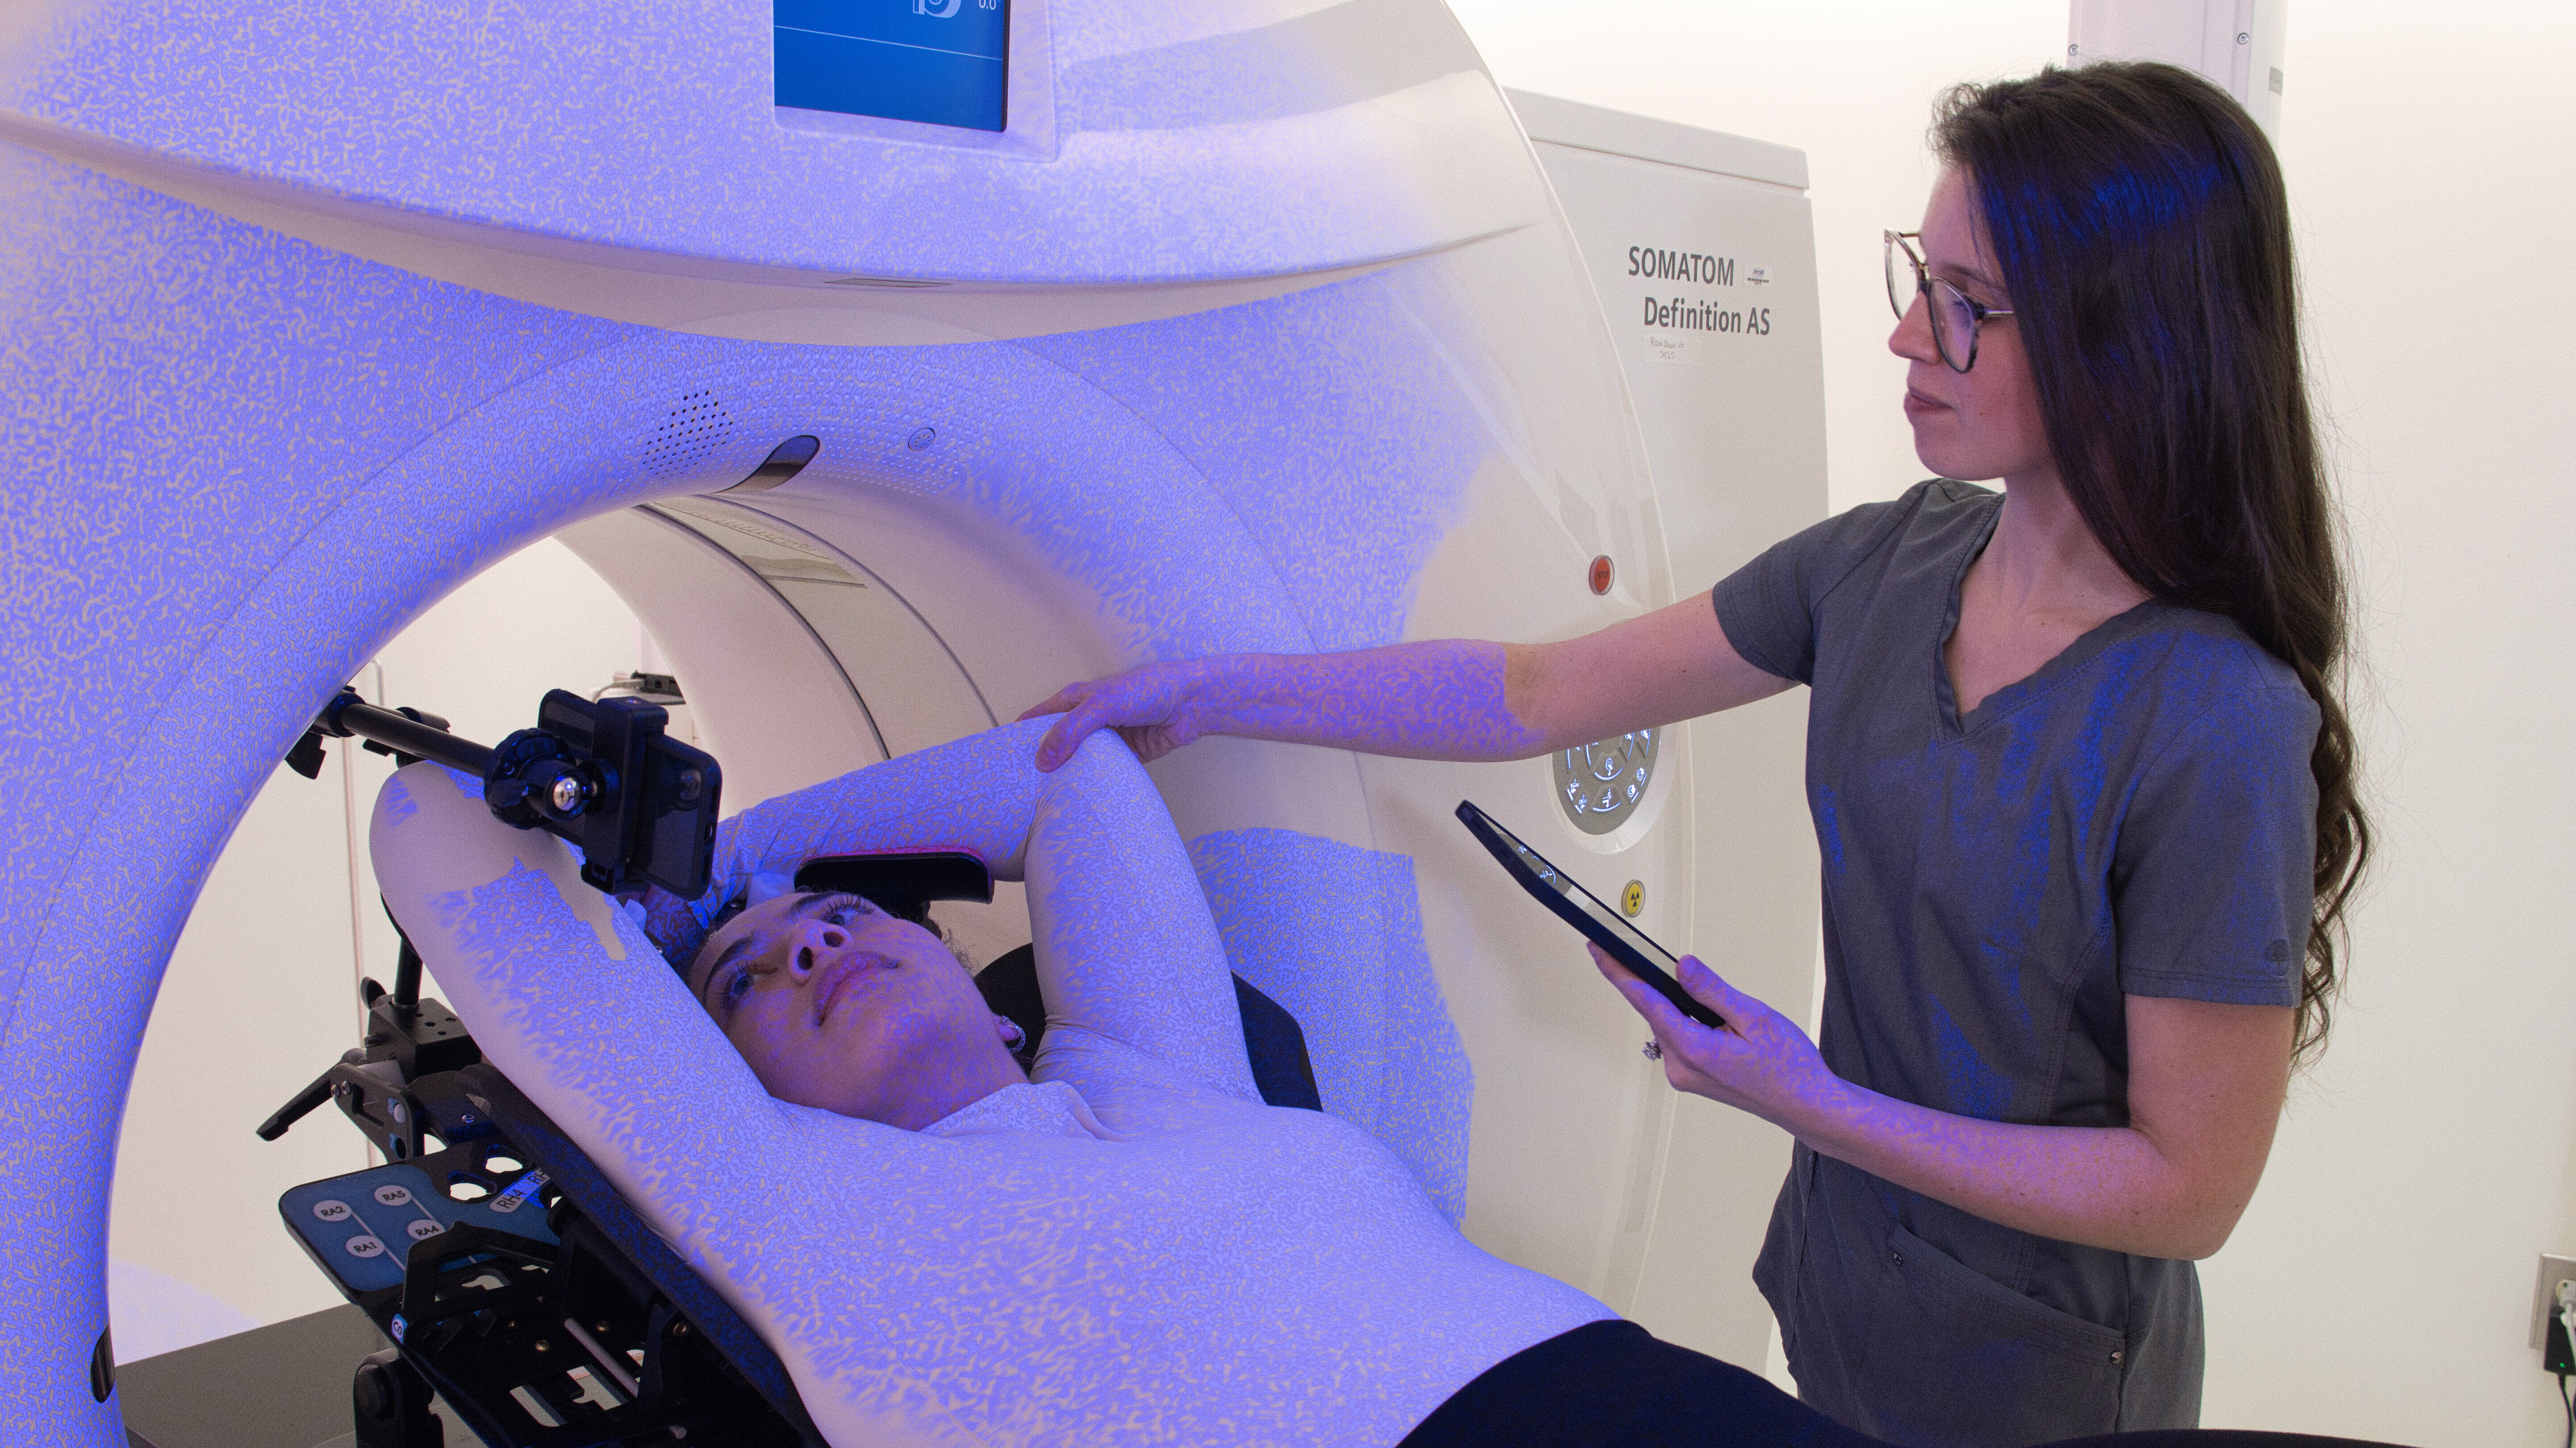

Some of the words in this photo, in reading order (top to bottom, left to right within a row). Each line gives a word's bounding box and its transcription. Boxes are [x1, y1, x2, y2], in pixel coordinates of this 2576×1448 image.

[1629, 245, 1734, 286] SOMATOM
[1644, 297, 1741, 333] Definition
[1747, 307, 1770, 335] AS
[382, 1190, 406, 1201] RA5
[496, 1190, 526, 1209] RH4
[320, 1206, 346, 1217] RA2
[415, 1225, 439, 1236] RA4
[353, 1241, 377, 1253] RA1
